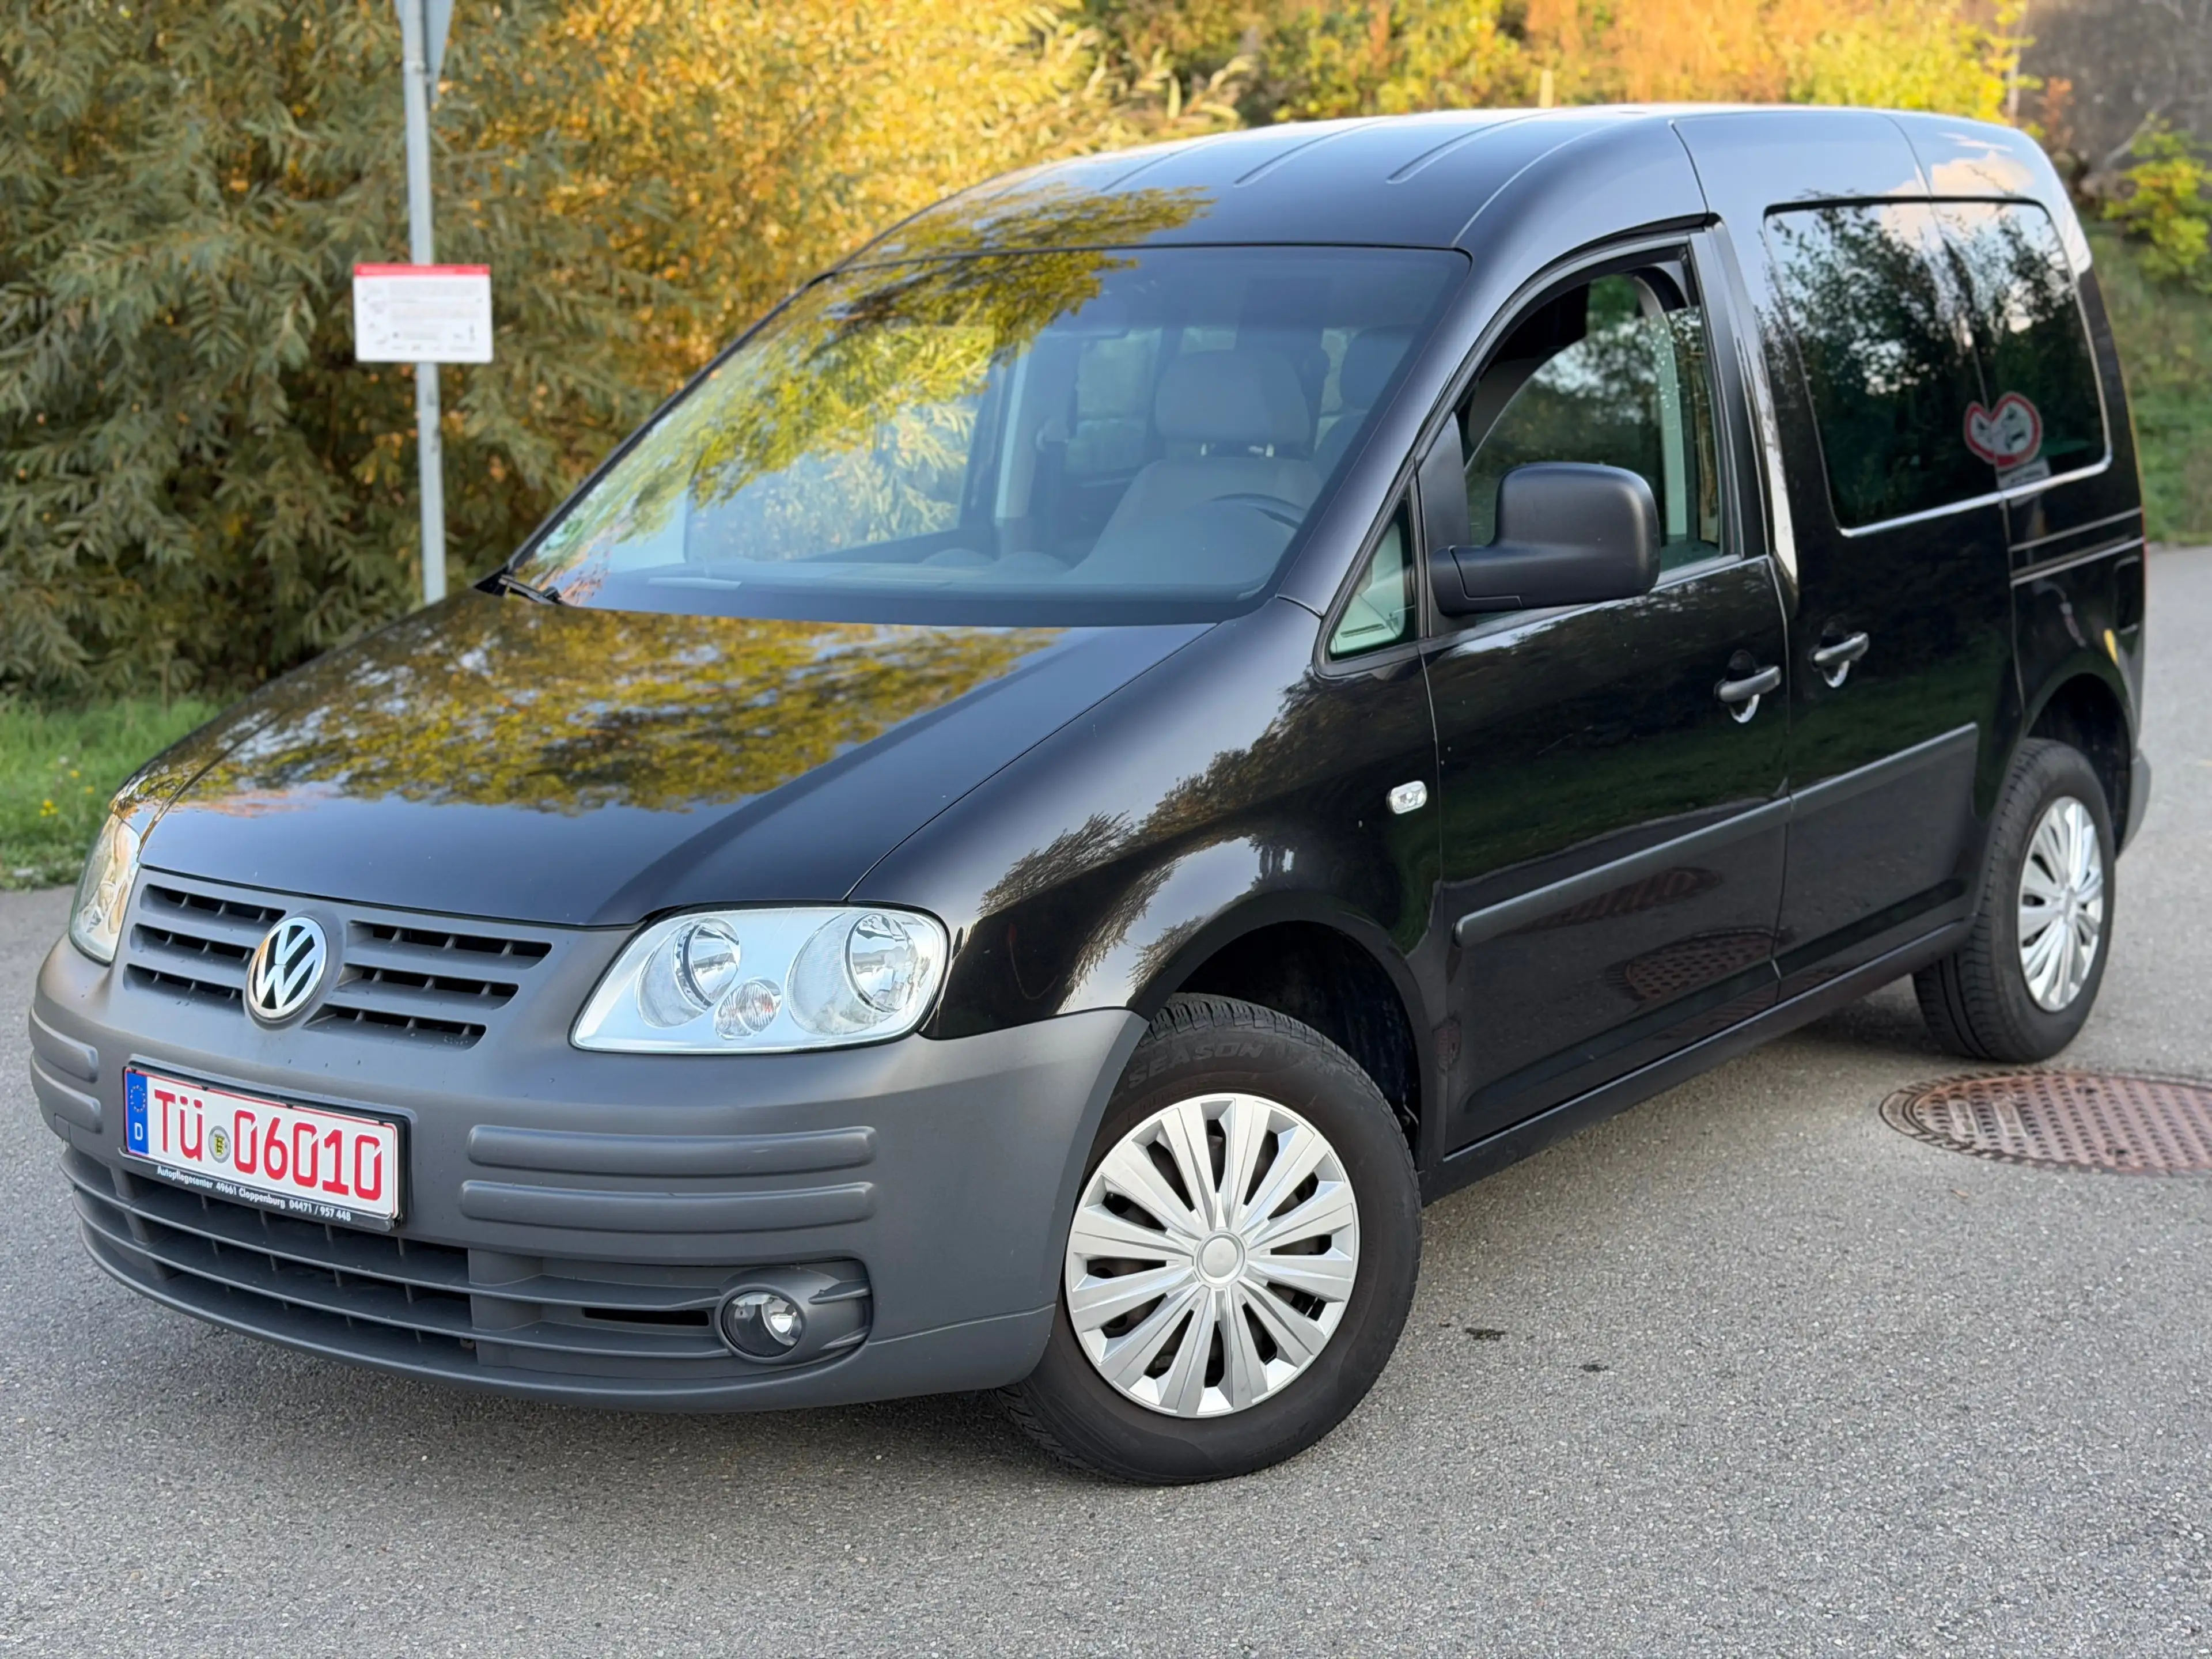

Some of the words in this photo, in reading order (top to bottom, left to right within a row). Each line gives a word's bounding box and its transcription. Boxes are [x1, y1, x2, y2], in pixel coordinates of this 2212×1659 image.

[252, 918, 325, 1016] VW
[1128, 1042, 1264, 1089] SEASON
[134, 1122, 143, 1141] D
[154, 1088, 203, 1162] TÜ
[233, 1109, 382, 1202] 06010
[157, 1165, 214, 1189] Autopflegecenter
[216, 1181, 237, 1196] 49661
[238, 1187, 286, 1210] Cloppenburg
[289, 1199, 312, 1214] 04471
[320, 1206, 335, 1218] 957
[336, 1210, 351, 1222] 448
